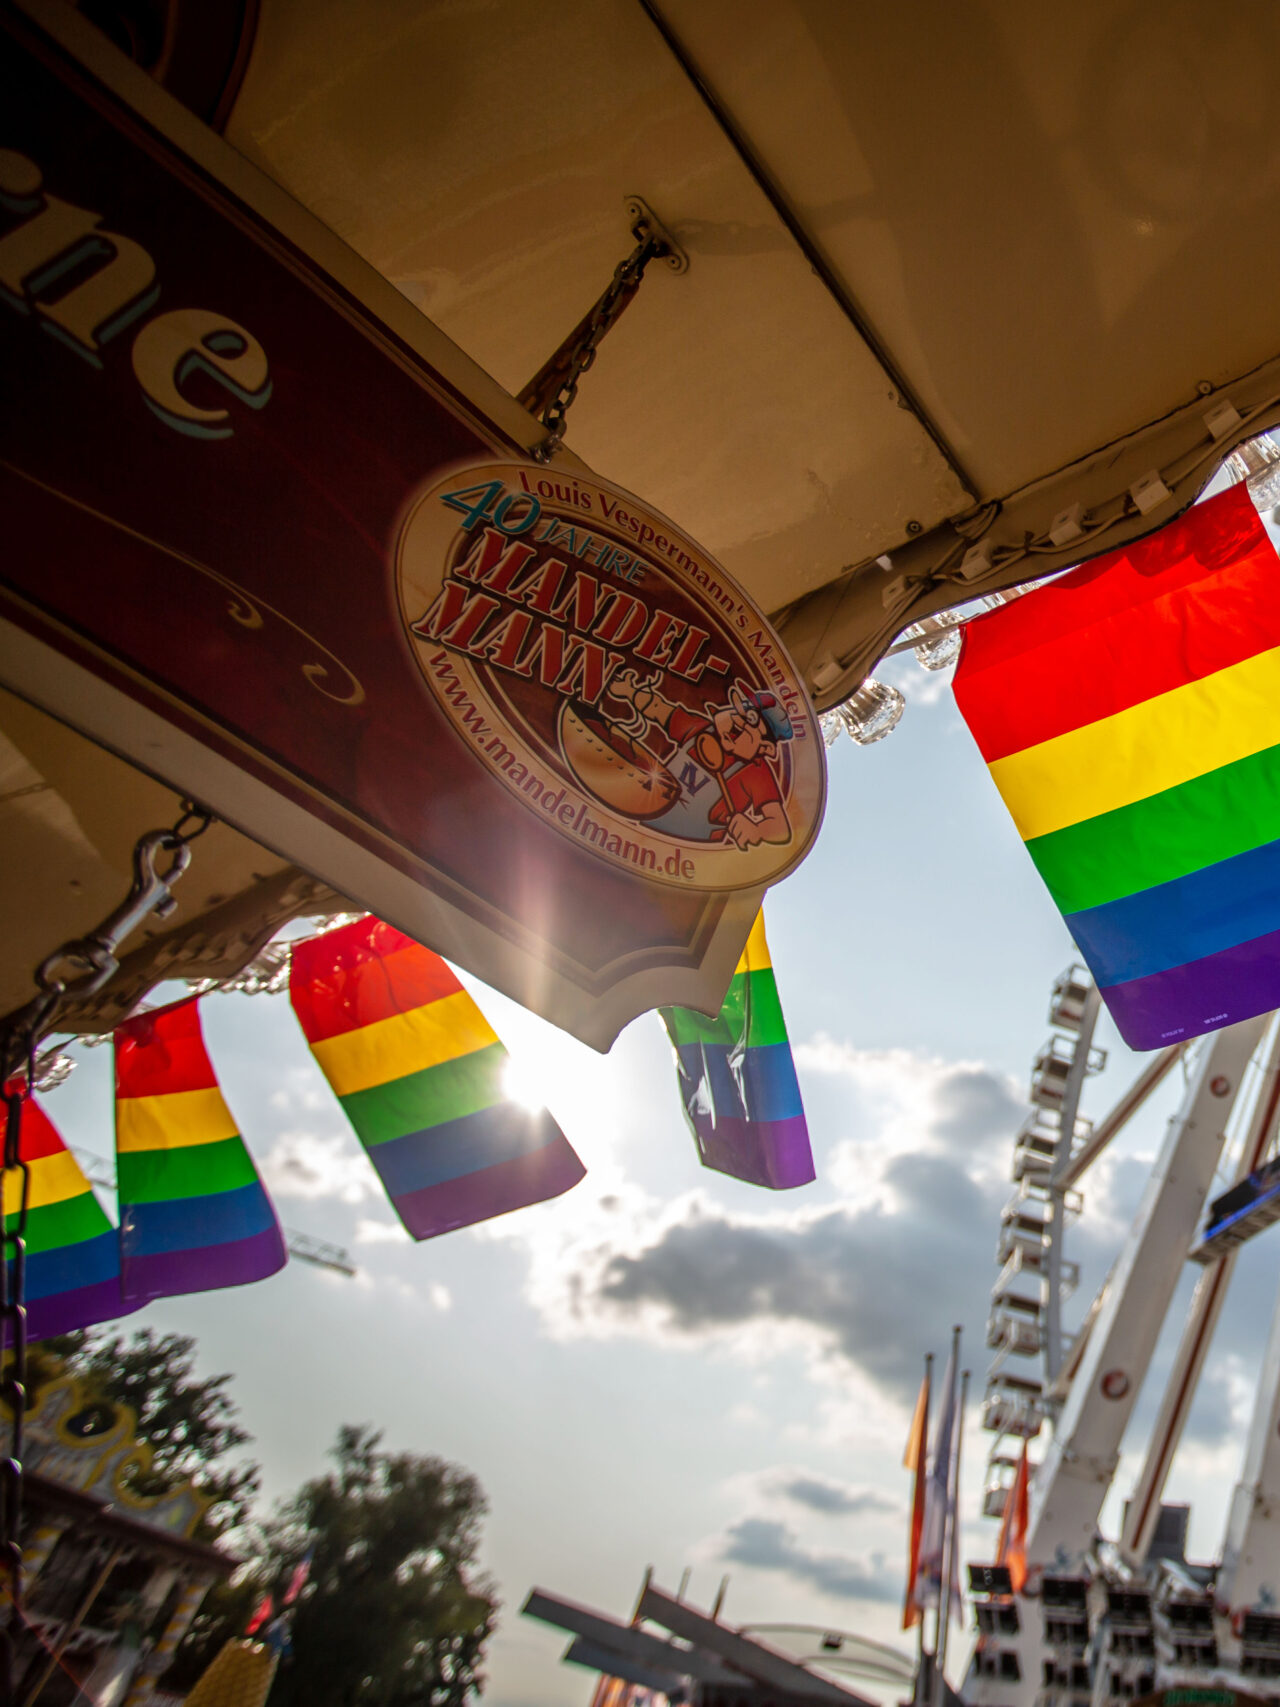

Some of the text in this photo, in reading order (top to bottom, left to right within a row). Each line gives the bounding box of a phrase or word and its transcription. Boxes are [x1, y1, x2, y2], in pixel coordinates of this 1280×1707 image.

[439, 480, 650, 585] 40 JAHRE
[452, 527, 732, 682] MANDEL-
[518, 471, 808, 739] Louis Vespermann's Mandeln
[410, 579, 626, 704] MANN
[429, 650, 696, 879] www.mandelmann.de
